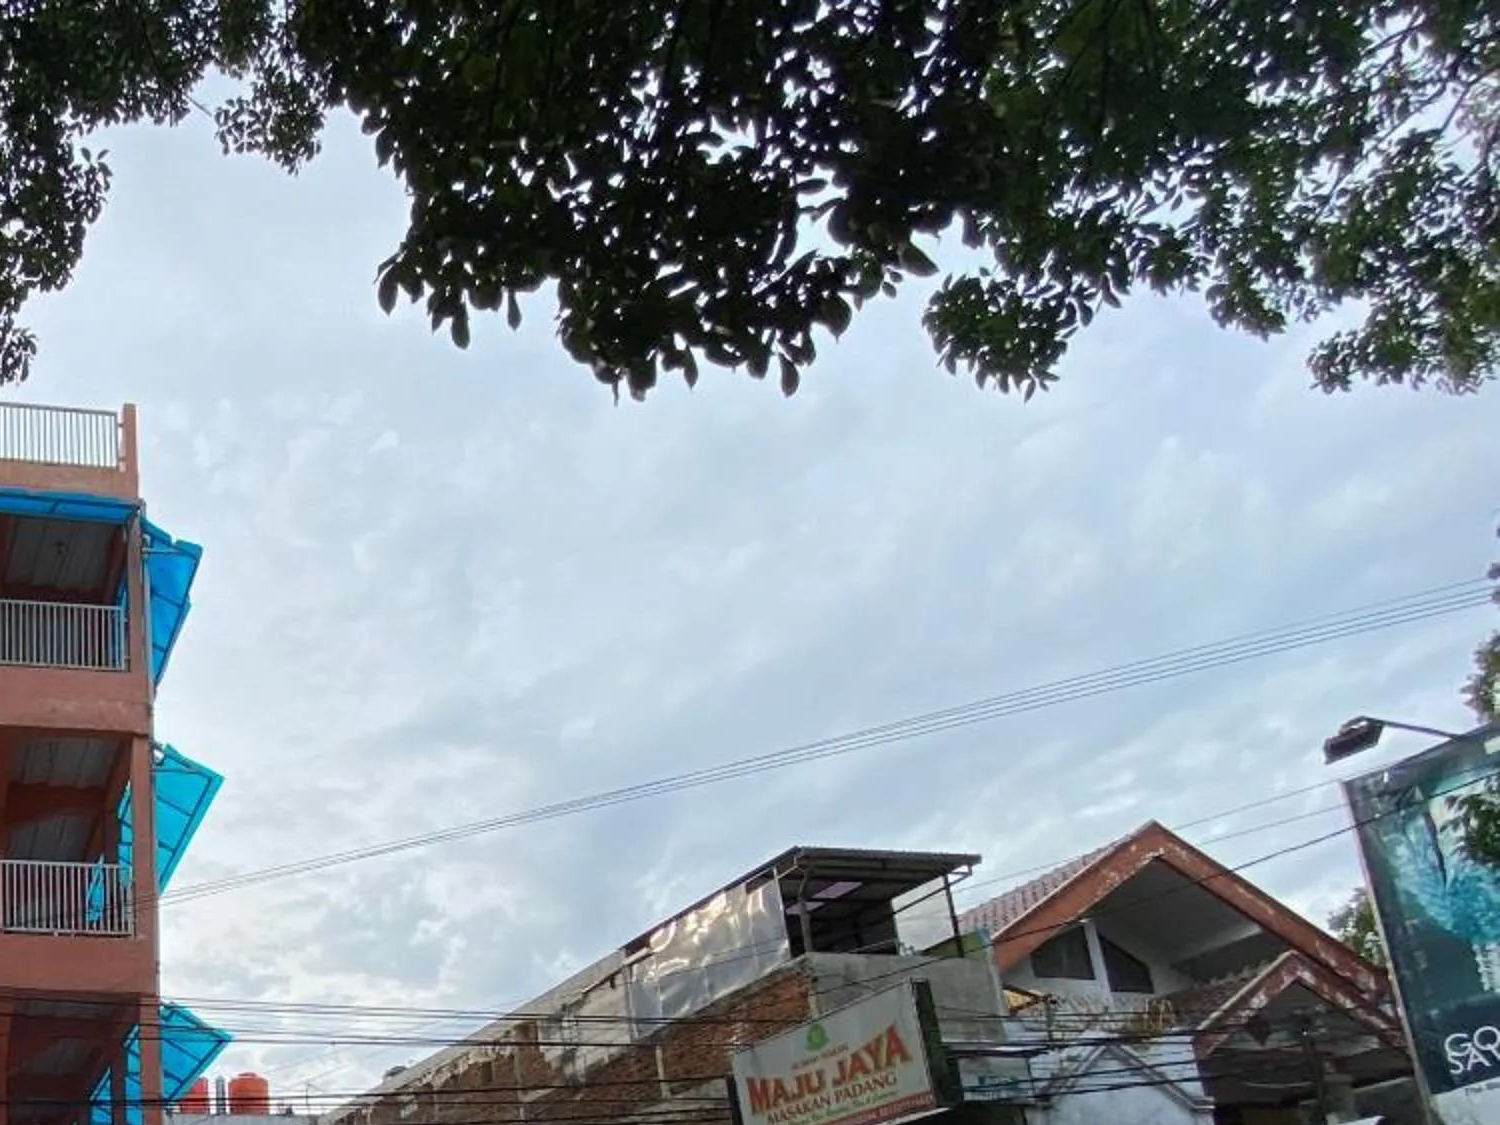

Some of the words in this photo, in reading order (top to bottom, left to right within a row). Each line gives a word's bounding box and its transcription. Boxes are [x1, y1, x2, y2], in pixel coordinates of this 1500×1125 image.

[746, 1067, 827, 1115] MAJU
[832, 1022, 913, 1087] JAYA
[767, 1094, 831, 1124] MASAKAN
[833, 1071, 898, 1101] PADANG
